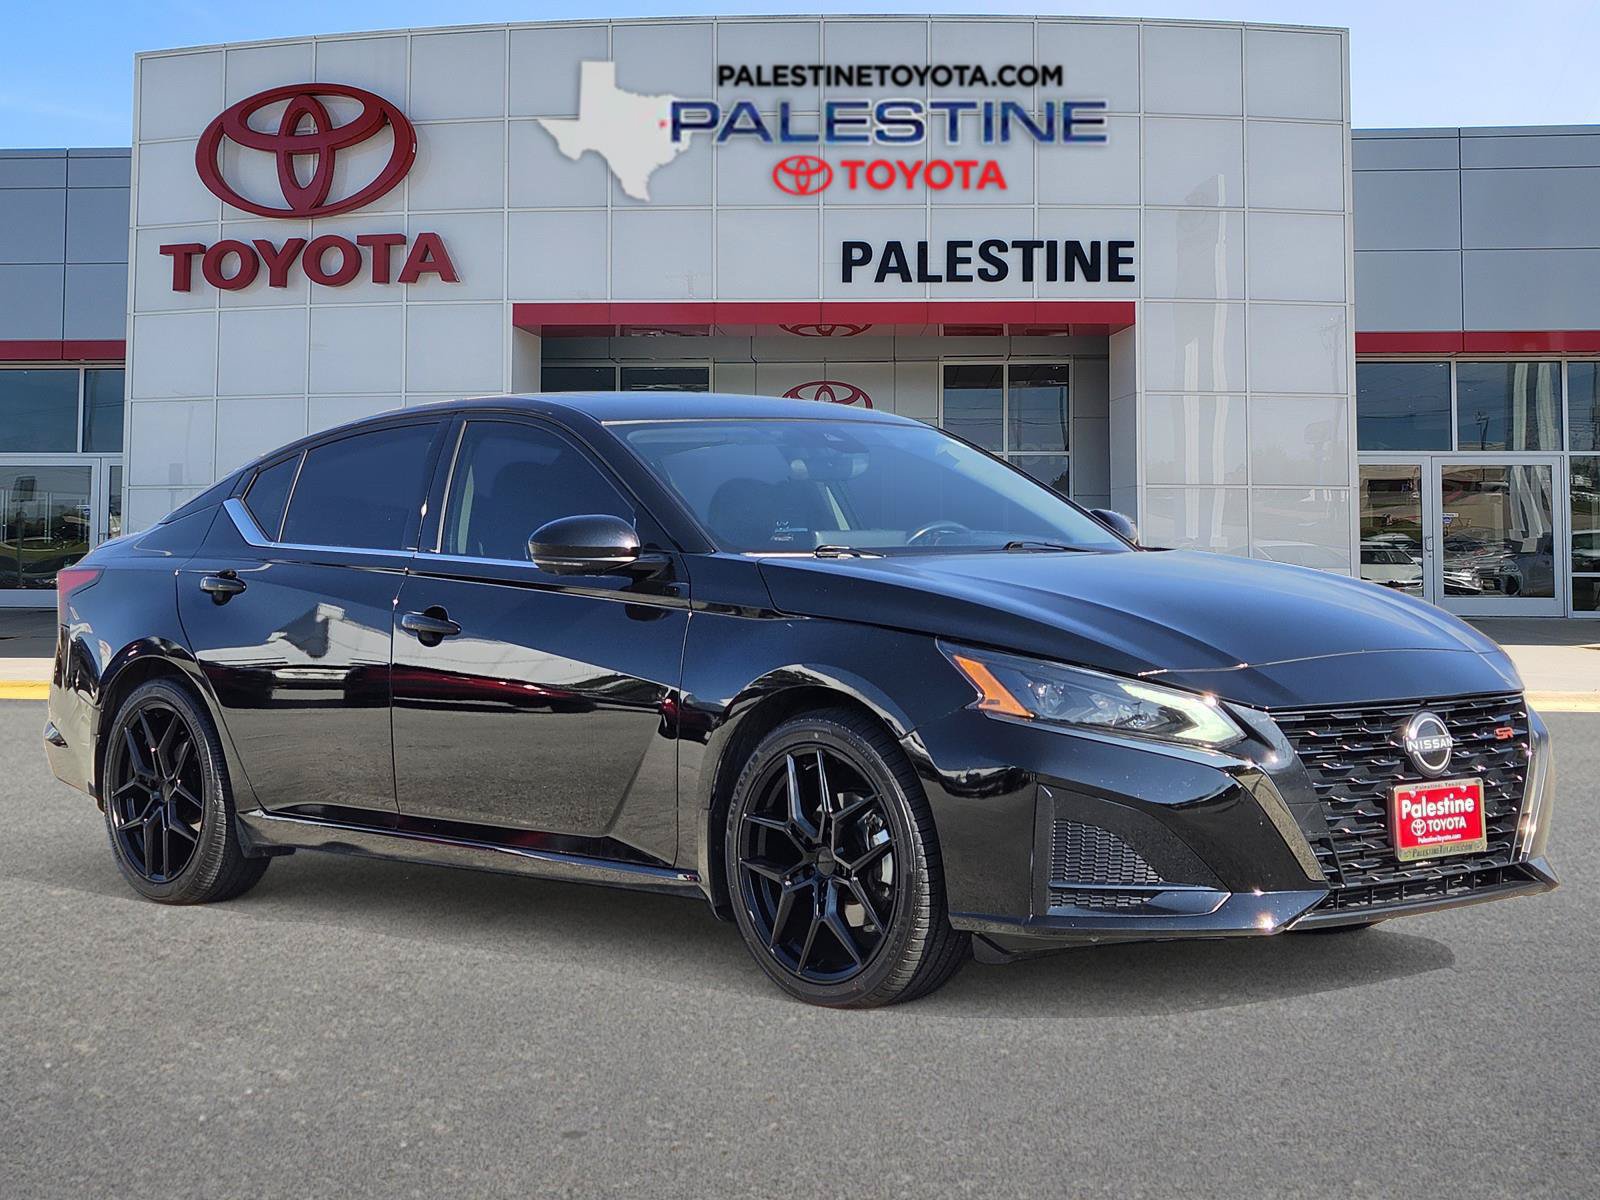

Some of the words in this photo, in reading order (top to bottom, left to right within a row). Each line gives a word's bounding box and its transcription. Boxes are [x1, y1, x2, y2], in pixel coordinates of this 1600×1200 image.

[159, 232, 460, 292] TOYOTA
[842, 239, 1136, 283] PALESTINE
[1407, 737, 1453, 753] NISSAN
[1401, 793, 1475, 819] Palestine
[1427, 816, 1467, 832] TOYOTA
